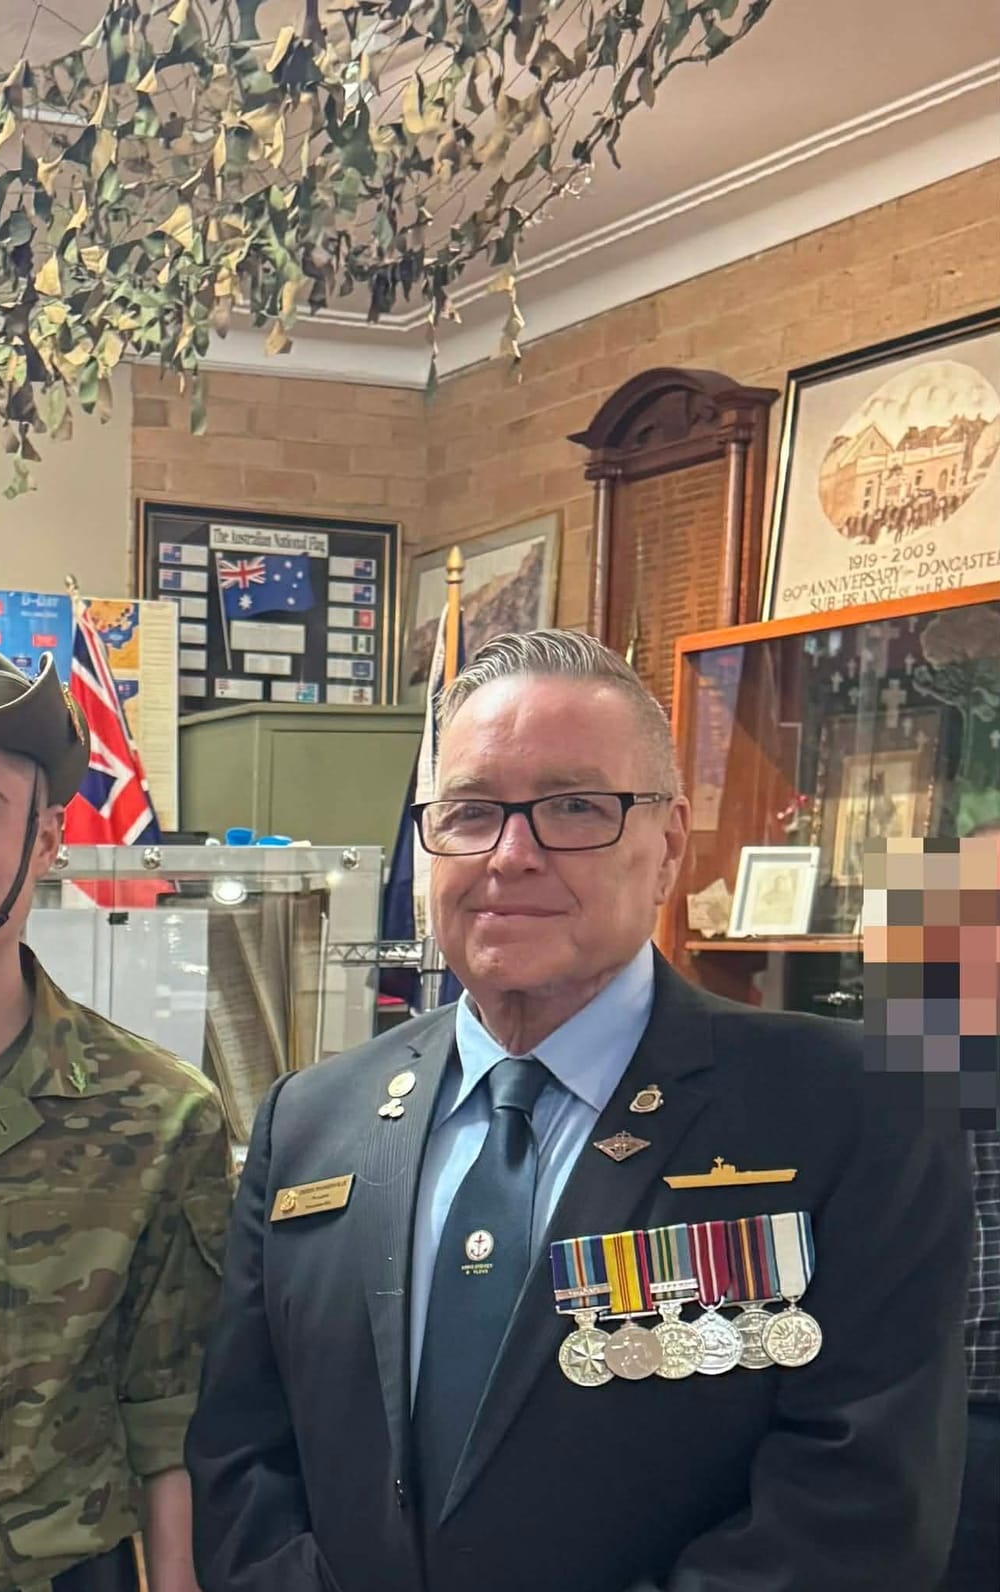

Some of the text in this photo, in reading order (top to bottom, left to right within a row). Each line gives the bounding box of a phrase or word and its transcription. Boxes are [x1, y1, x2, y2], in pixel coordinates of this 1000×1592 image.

[213, 527, 229, 544] The
[231, 531, 272, 548] Australian
[274, 534, 308, 551] National
[809, 565, 903, 596] ANNIVERSARY
[918, 549, 1000, 578] DONCASTE
